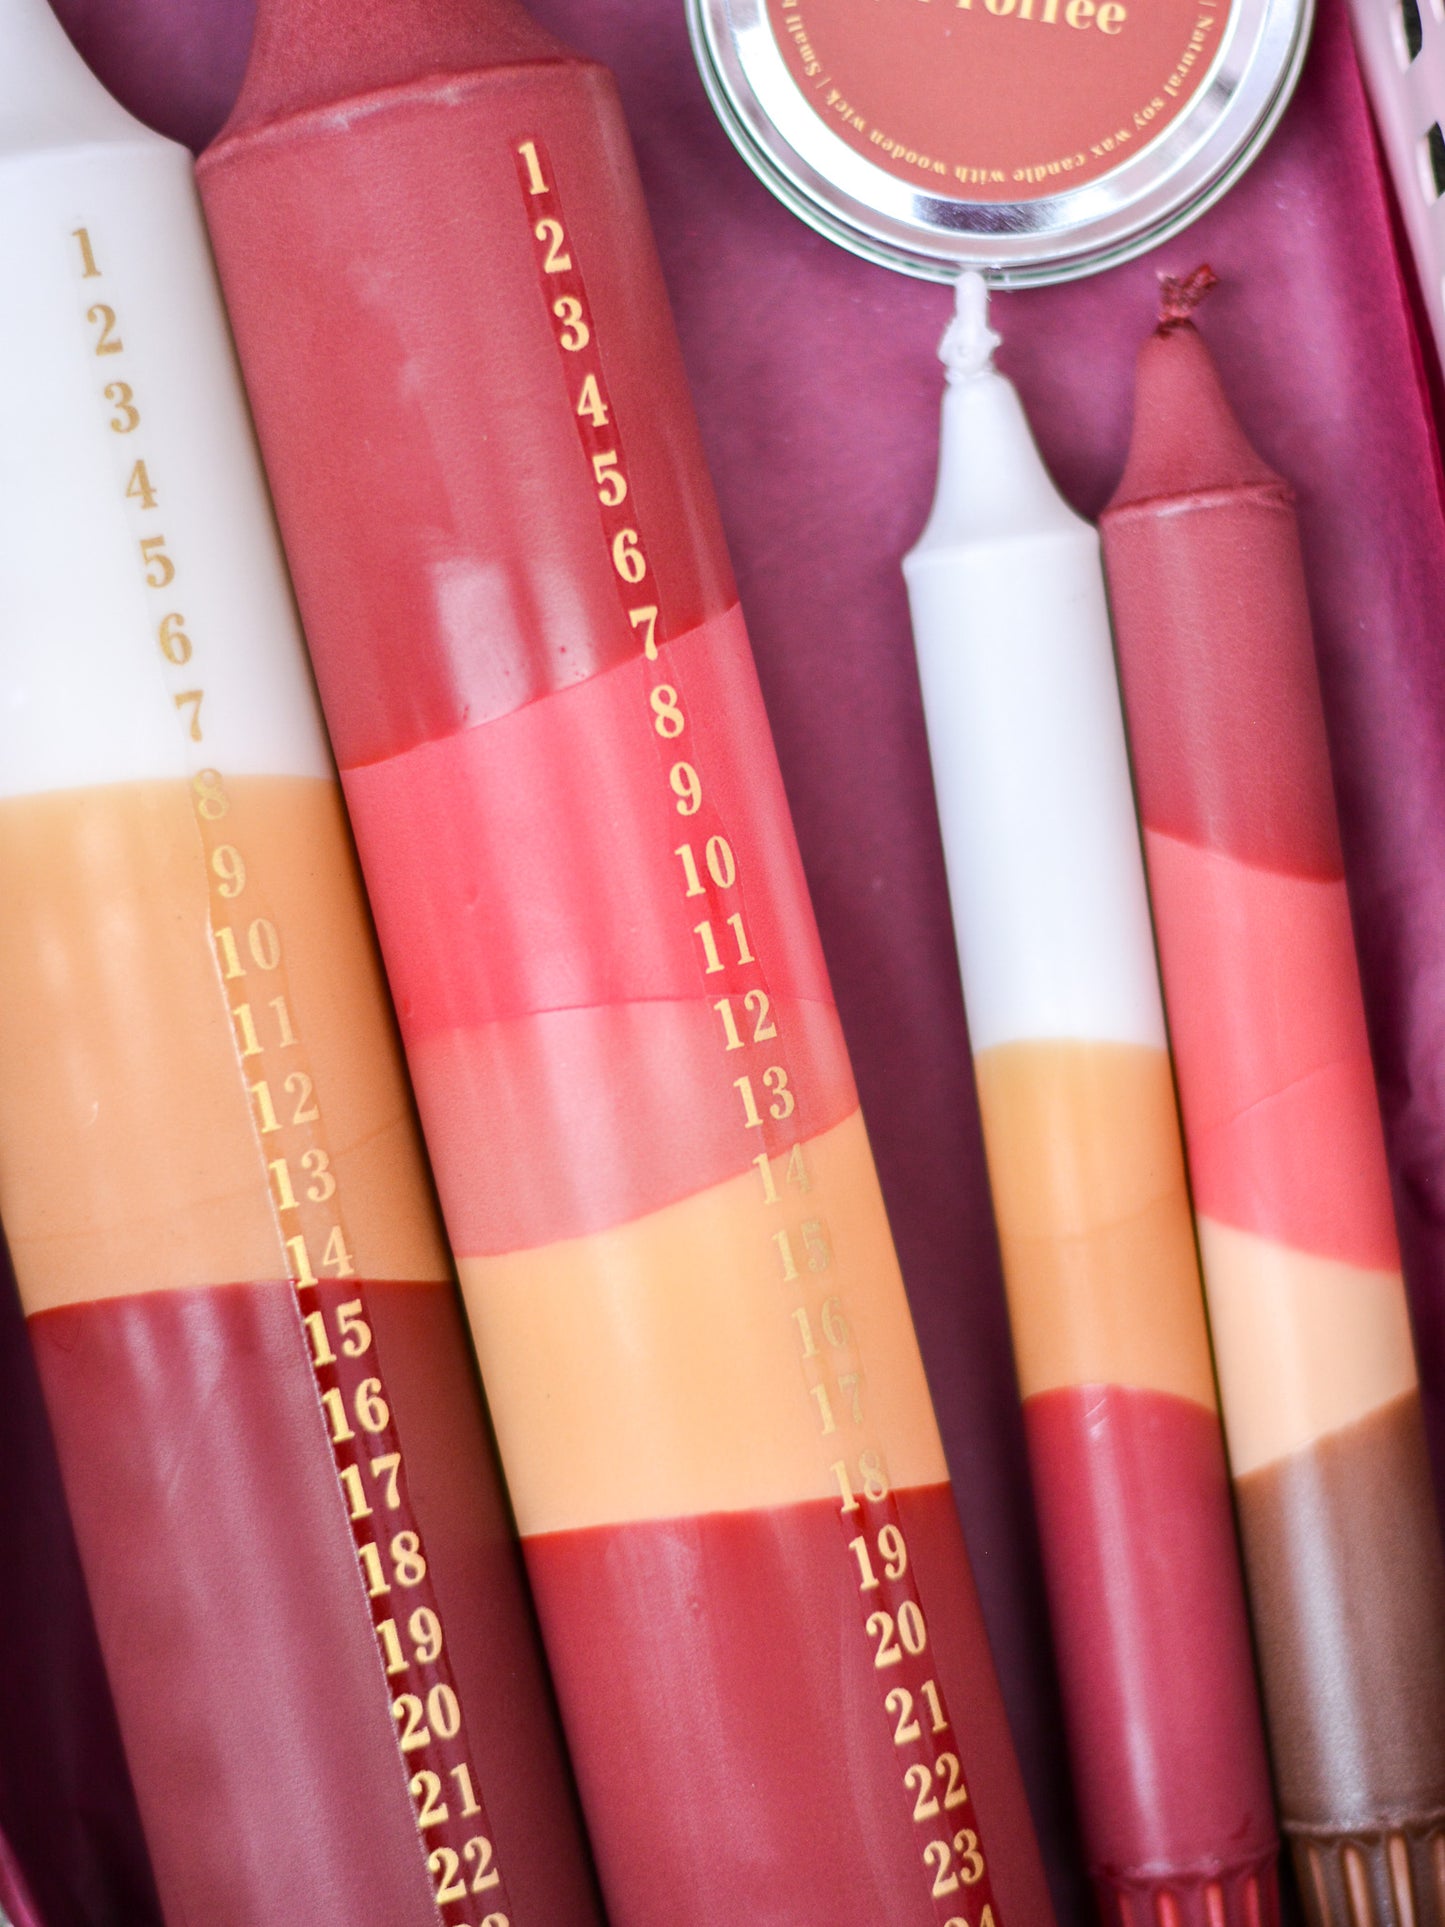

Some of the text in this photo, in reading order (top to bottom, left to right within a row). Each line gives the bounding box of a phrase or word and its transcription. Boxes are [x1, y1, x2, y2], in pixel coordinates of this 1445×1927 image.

[785, 15, 822, 76] Small
[1163, 15, 1215, 97] Natural
[826, 88, 866, 132] wick
[1133, 96, 1166, 130] soy
[517, 141, 550, 196] 1
[869, 129, 947, 175] wooden
[1013, 153, 1086, 184] candle
[1090, 129, 1132, 158] wax
[955, 165, 1005, 185] with
[71, 228, 102, 278] 1
[535, 218, 573, 274] 2
[86, 303, 123, 356] 2
[552, 296, 590, 352] 3
[104, 381, 141, 434] 3
[577, 374, 609, 427] 4
[125, 459, 158, 510] 4
[592, 449, 627, 507] 5
[139, 534, 175, 589] 5
[612, 528, 646, 583] 6
[158, 612, 193, 666] 6
[629, 605, 658, 661] 7
[174, 690, 204, 742] 7
[650, 684, 685, 738] 8
[192, 768, 229, 820] 8
[669, 761, 703, 816] 9
[211, 845, 246, 898] 9
[674, 835, 736, 898] 10
[215, 918, 281, 980] 10
[693, 912, 755, 975] 11
[232, 996, 299, 1056] 11
[713, 988, 778, 1052] 12
[251, 1072, 320, 1133] 12
[732, 1065, 795, 1129] 13
[269, 1148, 336, 1211] 13
[752, 1143, 811, 1206] 14
[286, 1226, 354, 1289] 14
[771, 1218, 831, 1283] 15
[304, 1298, 372, 1367] 15
[791, 1297, 849, 1359] 16
[322, 1376, 390, 1444] 16
[809, 1372, 864, 1436] 17
[340, 1452, 402, 1520] 17
[829, 1449, 889, 1514] 18
[358, 1530, 427, 1598] 18
[848, 1523, 907, 1592] 19
[376, 1606, 443, 1674] 19
[865, 1600, 927, 1669] 20
[392, 1683, 461, 1752] 20
[884, 1679, 948, 1745] 21
[410, 1763, 481, 1828] 21
[904, 1752, 968, 1823] 22
[428, 1836, 499, 1904] 22
[923, 1828, 984, 1900] 23
